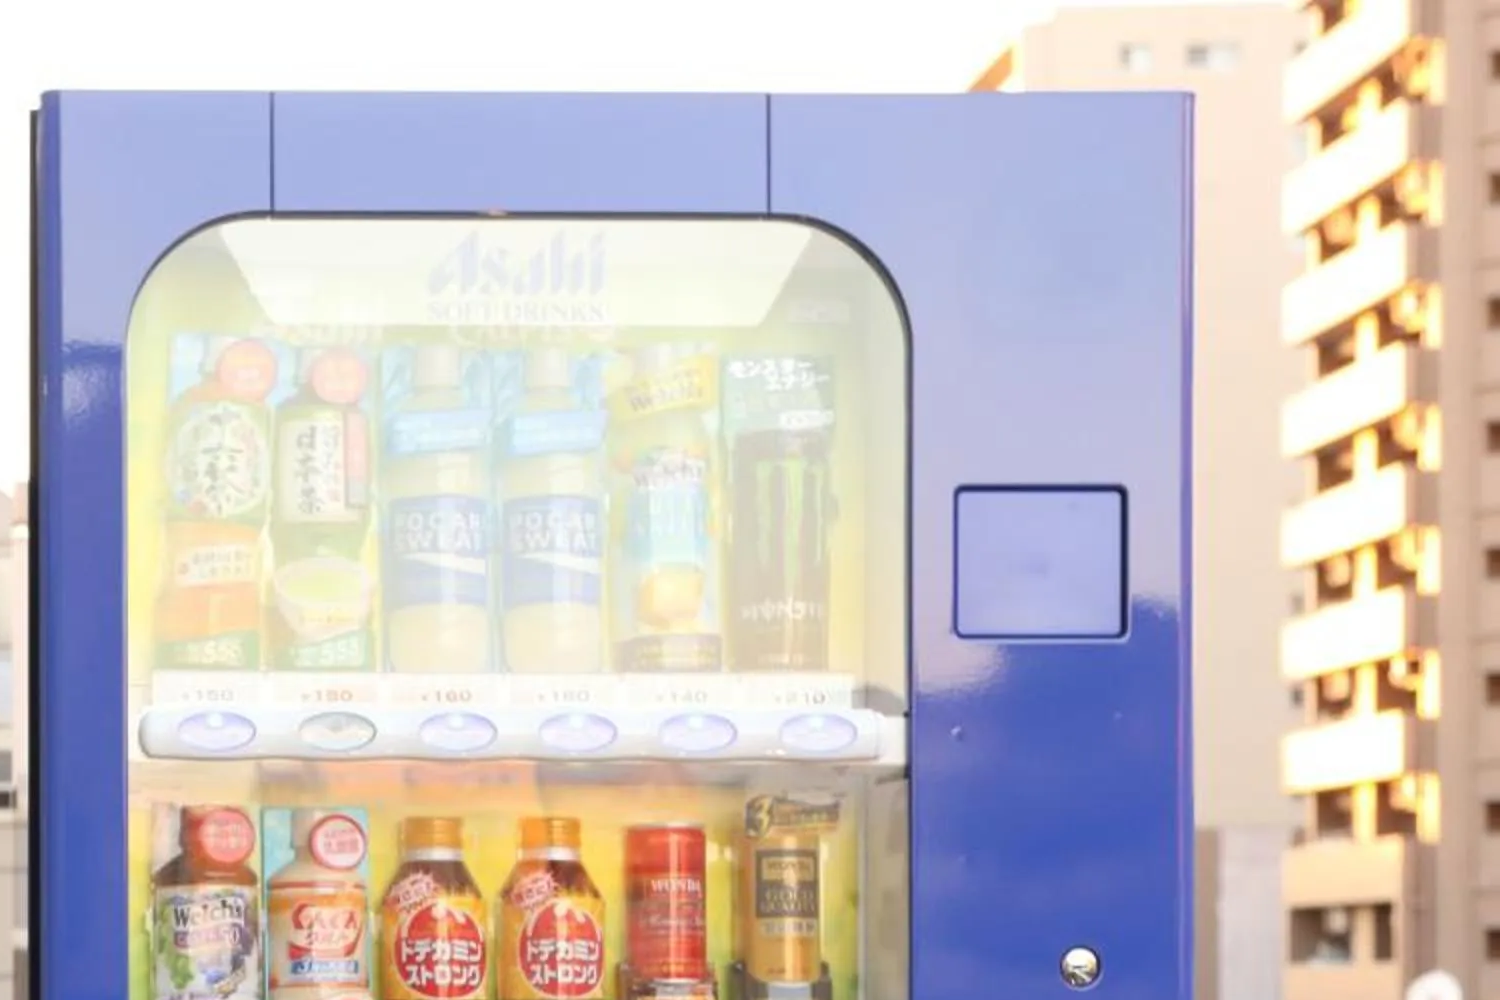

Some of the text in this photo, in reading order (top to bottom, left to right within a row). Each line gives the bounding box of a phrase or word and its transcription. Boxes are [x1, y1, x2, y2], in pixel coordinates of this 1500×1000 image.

[405, 964, 480, 987] ストロング
[530, 963, 598, 986] ストロング
